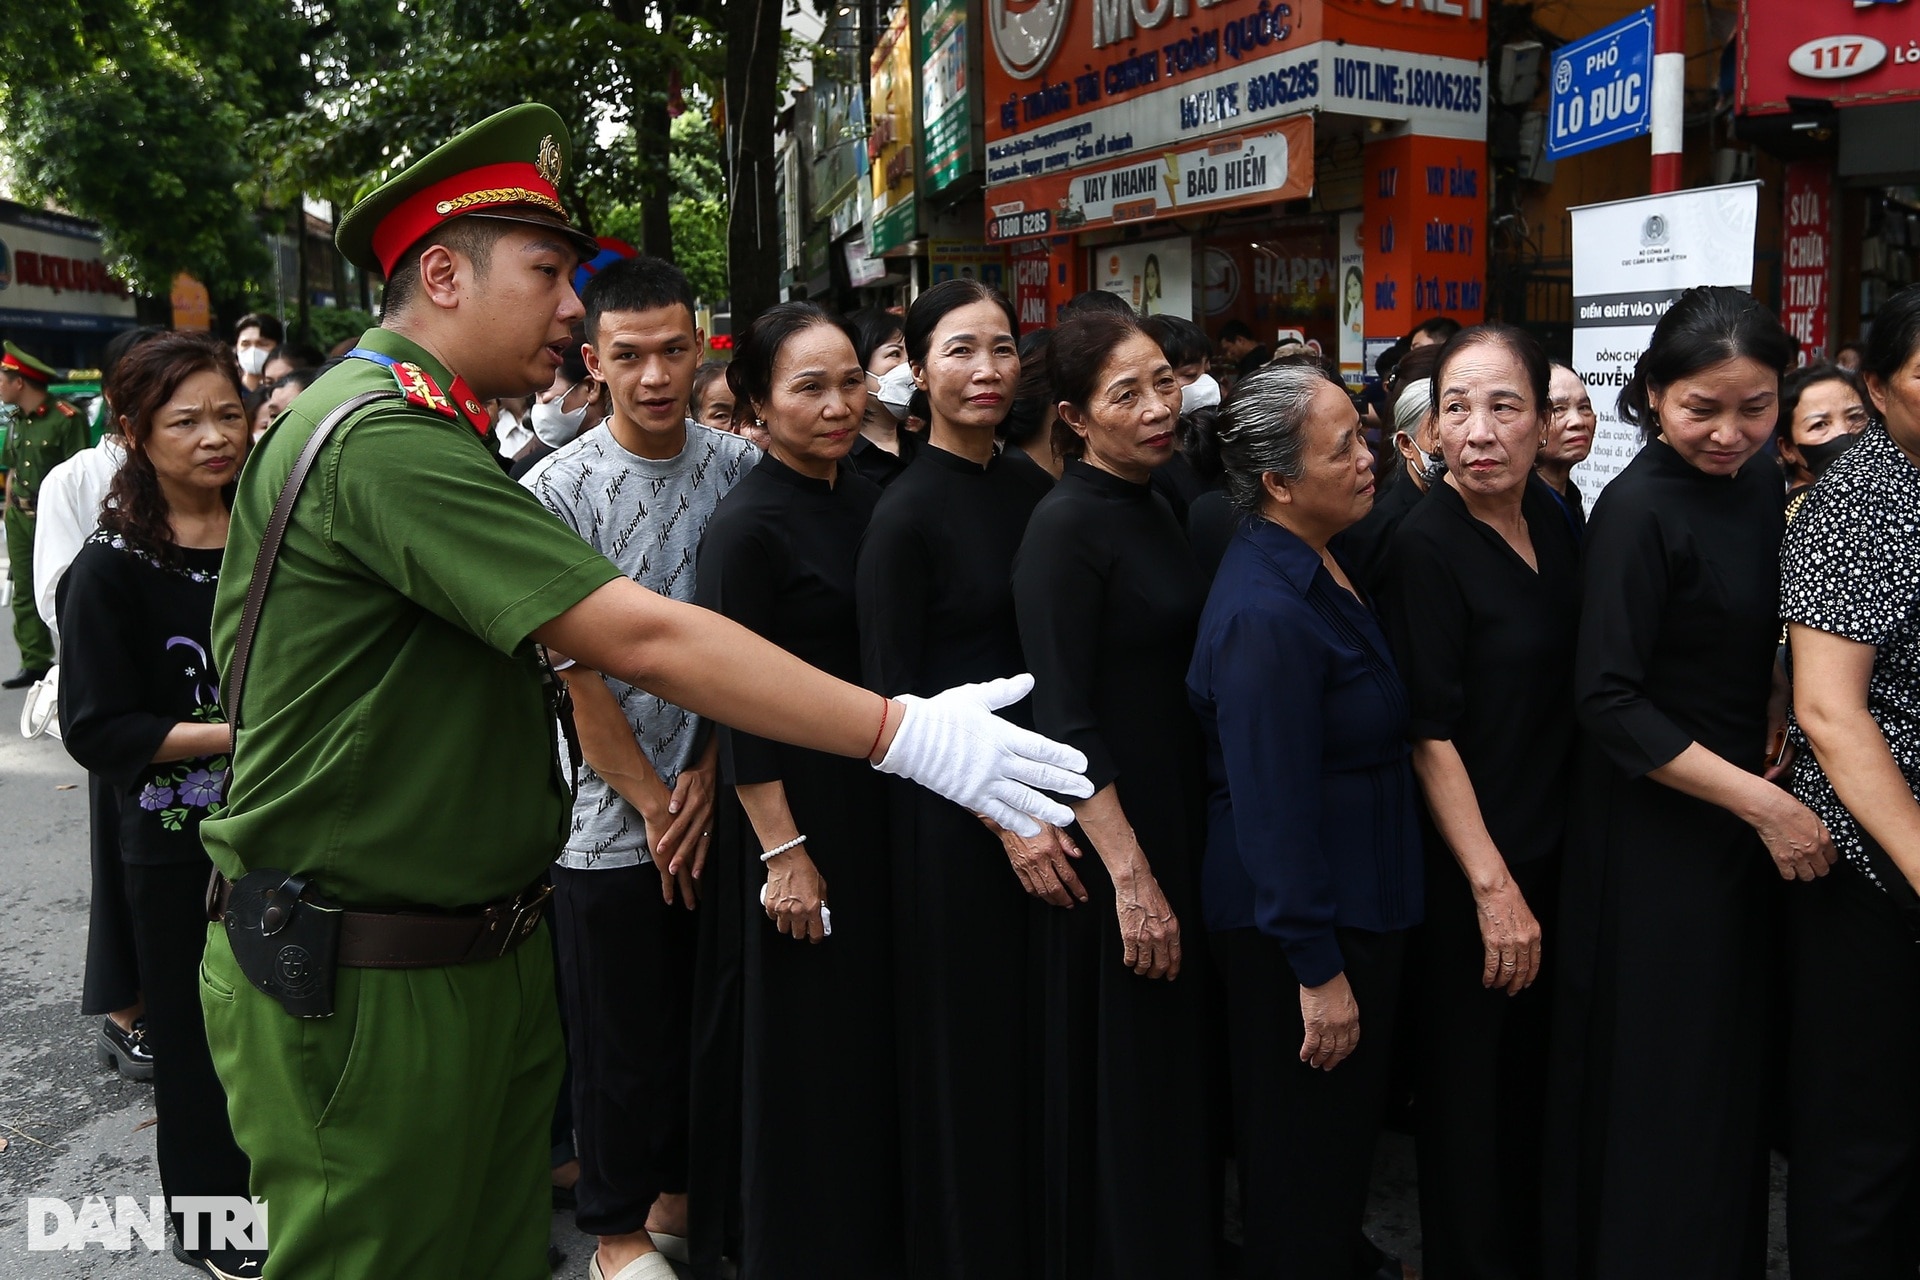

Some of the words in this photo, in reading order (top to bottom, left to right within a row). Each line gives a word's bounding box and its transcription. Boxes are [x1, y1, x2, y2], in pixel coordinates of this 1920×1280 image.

[1224, 1, 1291, 60] QUỐC
[1586, 35, 1622, 75] PHỐ
[1811, 43, 1863, 70] 117
[1894, 40, 1920, 64] Lò
[1556, 86, 1585, 138] LÒ
[1589, 69, 1642, 127] ĐÚC
[1084, 175, 1106, 203] VAY
[1112, 164, 1157, 199] NHANH
[1187, 157, 1217, 197] BẢO
[1225, 146, 1267, 190] HIỂM
[998, 216, 1020, 238] 1800
[1022, 211, 1046, 234] 6285
[1790, 186, 1819, 226] SỬA
[1789, 232, 1825, 268] CHỮA
[1254, 257, 1337, 294] HAPPY
[1788, 275, 1822, 307] THAY
[1580, 302, 1602, 319] ĐIỂM
[1603, 302, 1629, 317] QUÉT
[1630, 301, 1653, 317] VÀO
[1789, 307, 1817, 344] THẾ
[1596, 347, 1622, 361] ĐỒNG
[1623, 348, 1640, 361] CHÍ
[1580, 365, 1632, 386] NGUYỄN
[691, 442, 717, 490] Lifework
[724, 439, 755, 487] Lifework
[1594, 444, 1613, 457] thoại
[1615, 446, 1623, 455] di
[1594, 460, 1610, 474] hoạt
[1577, 475, 1587, 487] khi
[612, 500, 649, 559] Lifework
[658, 493, 690, 551] Lifework
[656, 547, 693, 598] ifework
[651, 711, 691, 764] Lifework
[585, 816, 630, 868] Lifework
